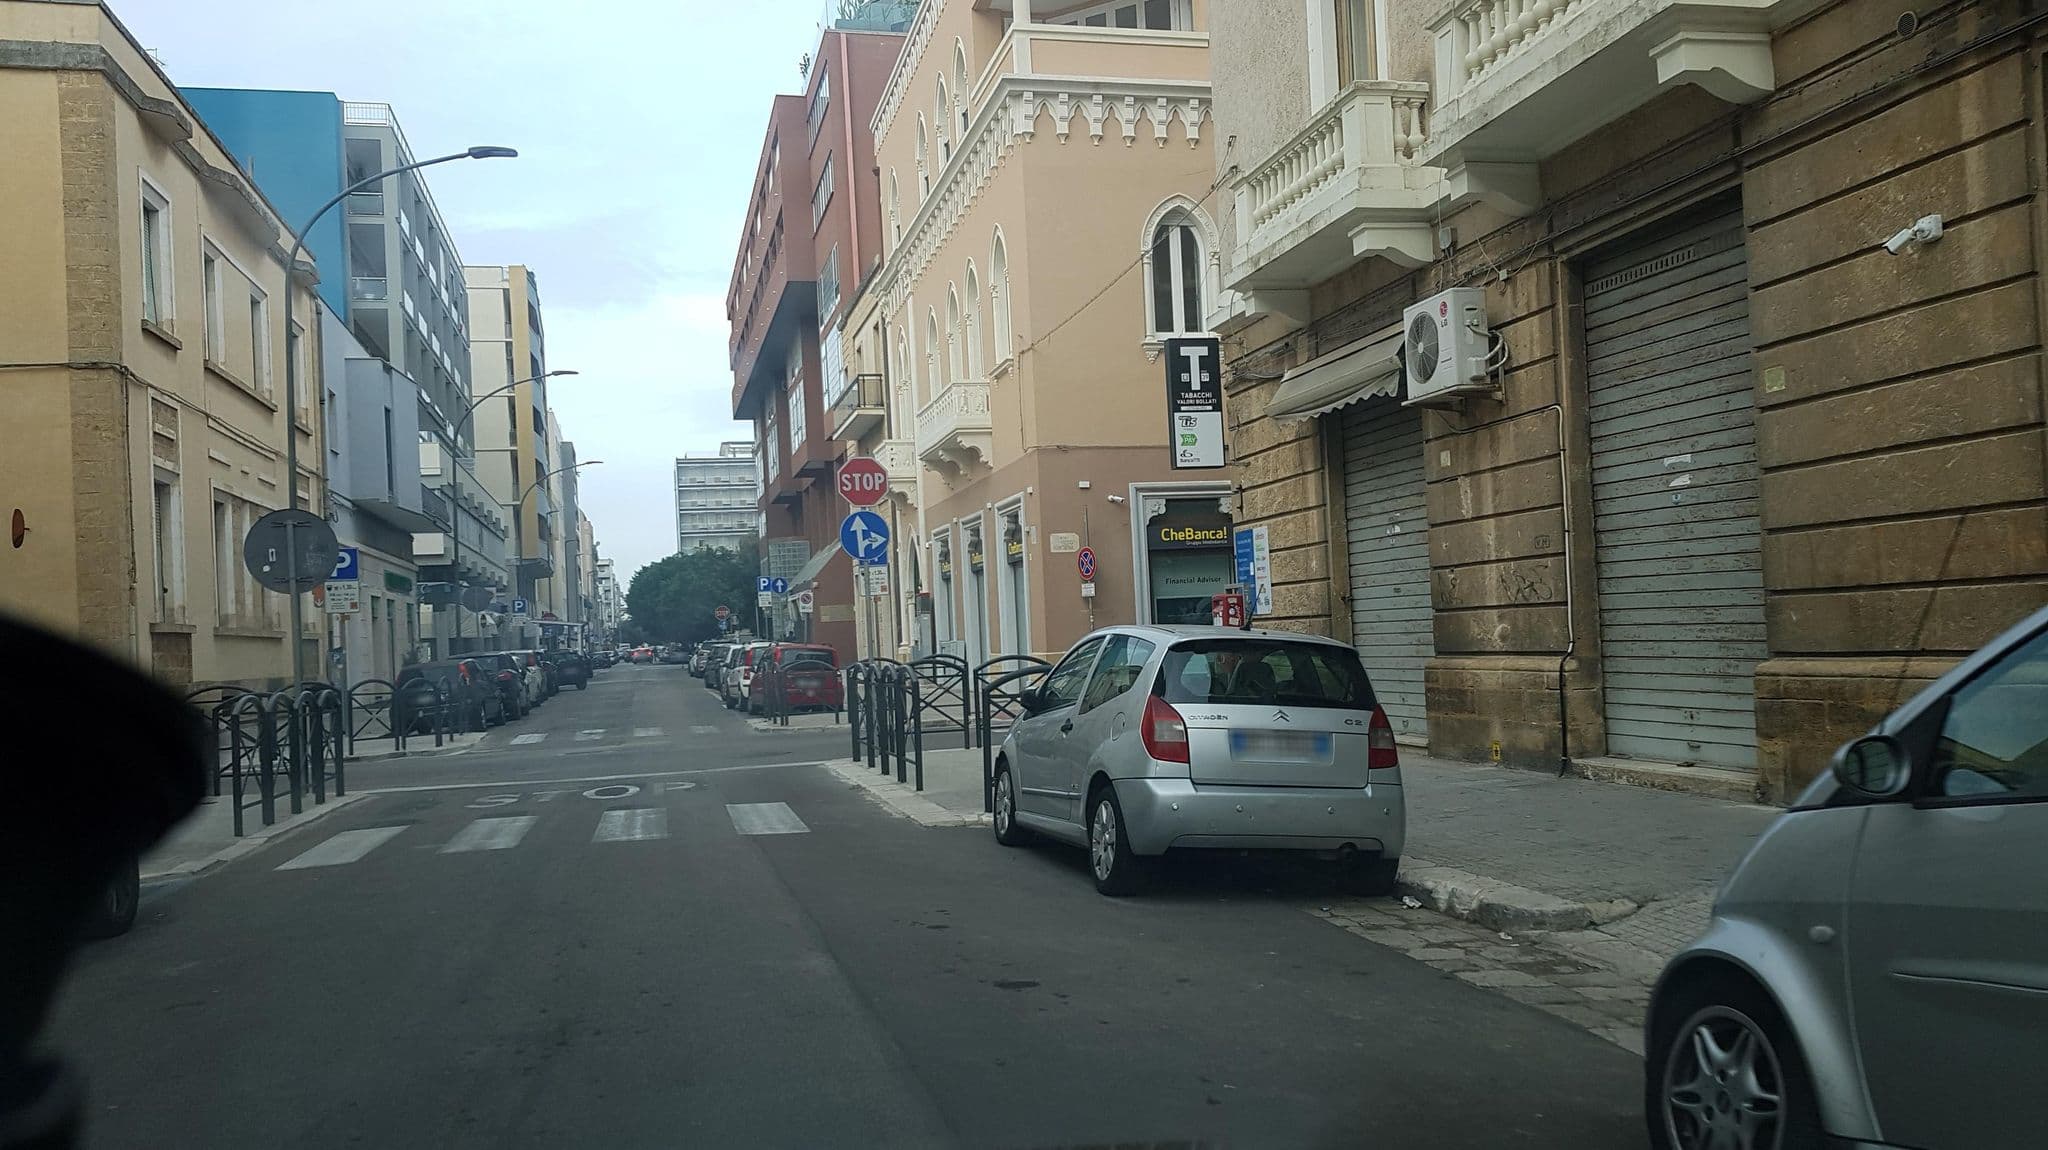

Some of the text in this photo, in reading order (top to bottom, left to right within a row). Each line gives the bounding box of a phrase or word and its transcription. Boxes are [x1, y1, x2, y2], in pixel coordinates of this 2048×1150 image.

[1440, 318, 1449, 328] LG
[1180, 346, 1208, 390] T
[841, 472, 886, 492] STOP
[1161, 526, 1229, 541] CheBanca!
[332, 551, 352, 577] P
[760, 578, 769, 590] P
[1196, 576, 1222, 584] Advisor
[514, 600, 524, 612] P
[1343, 718, 1364, 726] C2
[463, 782, 697, 808] STOP
